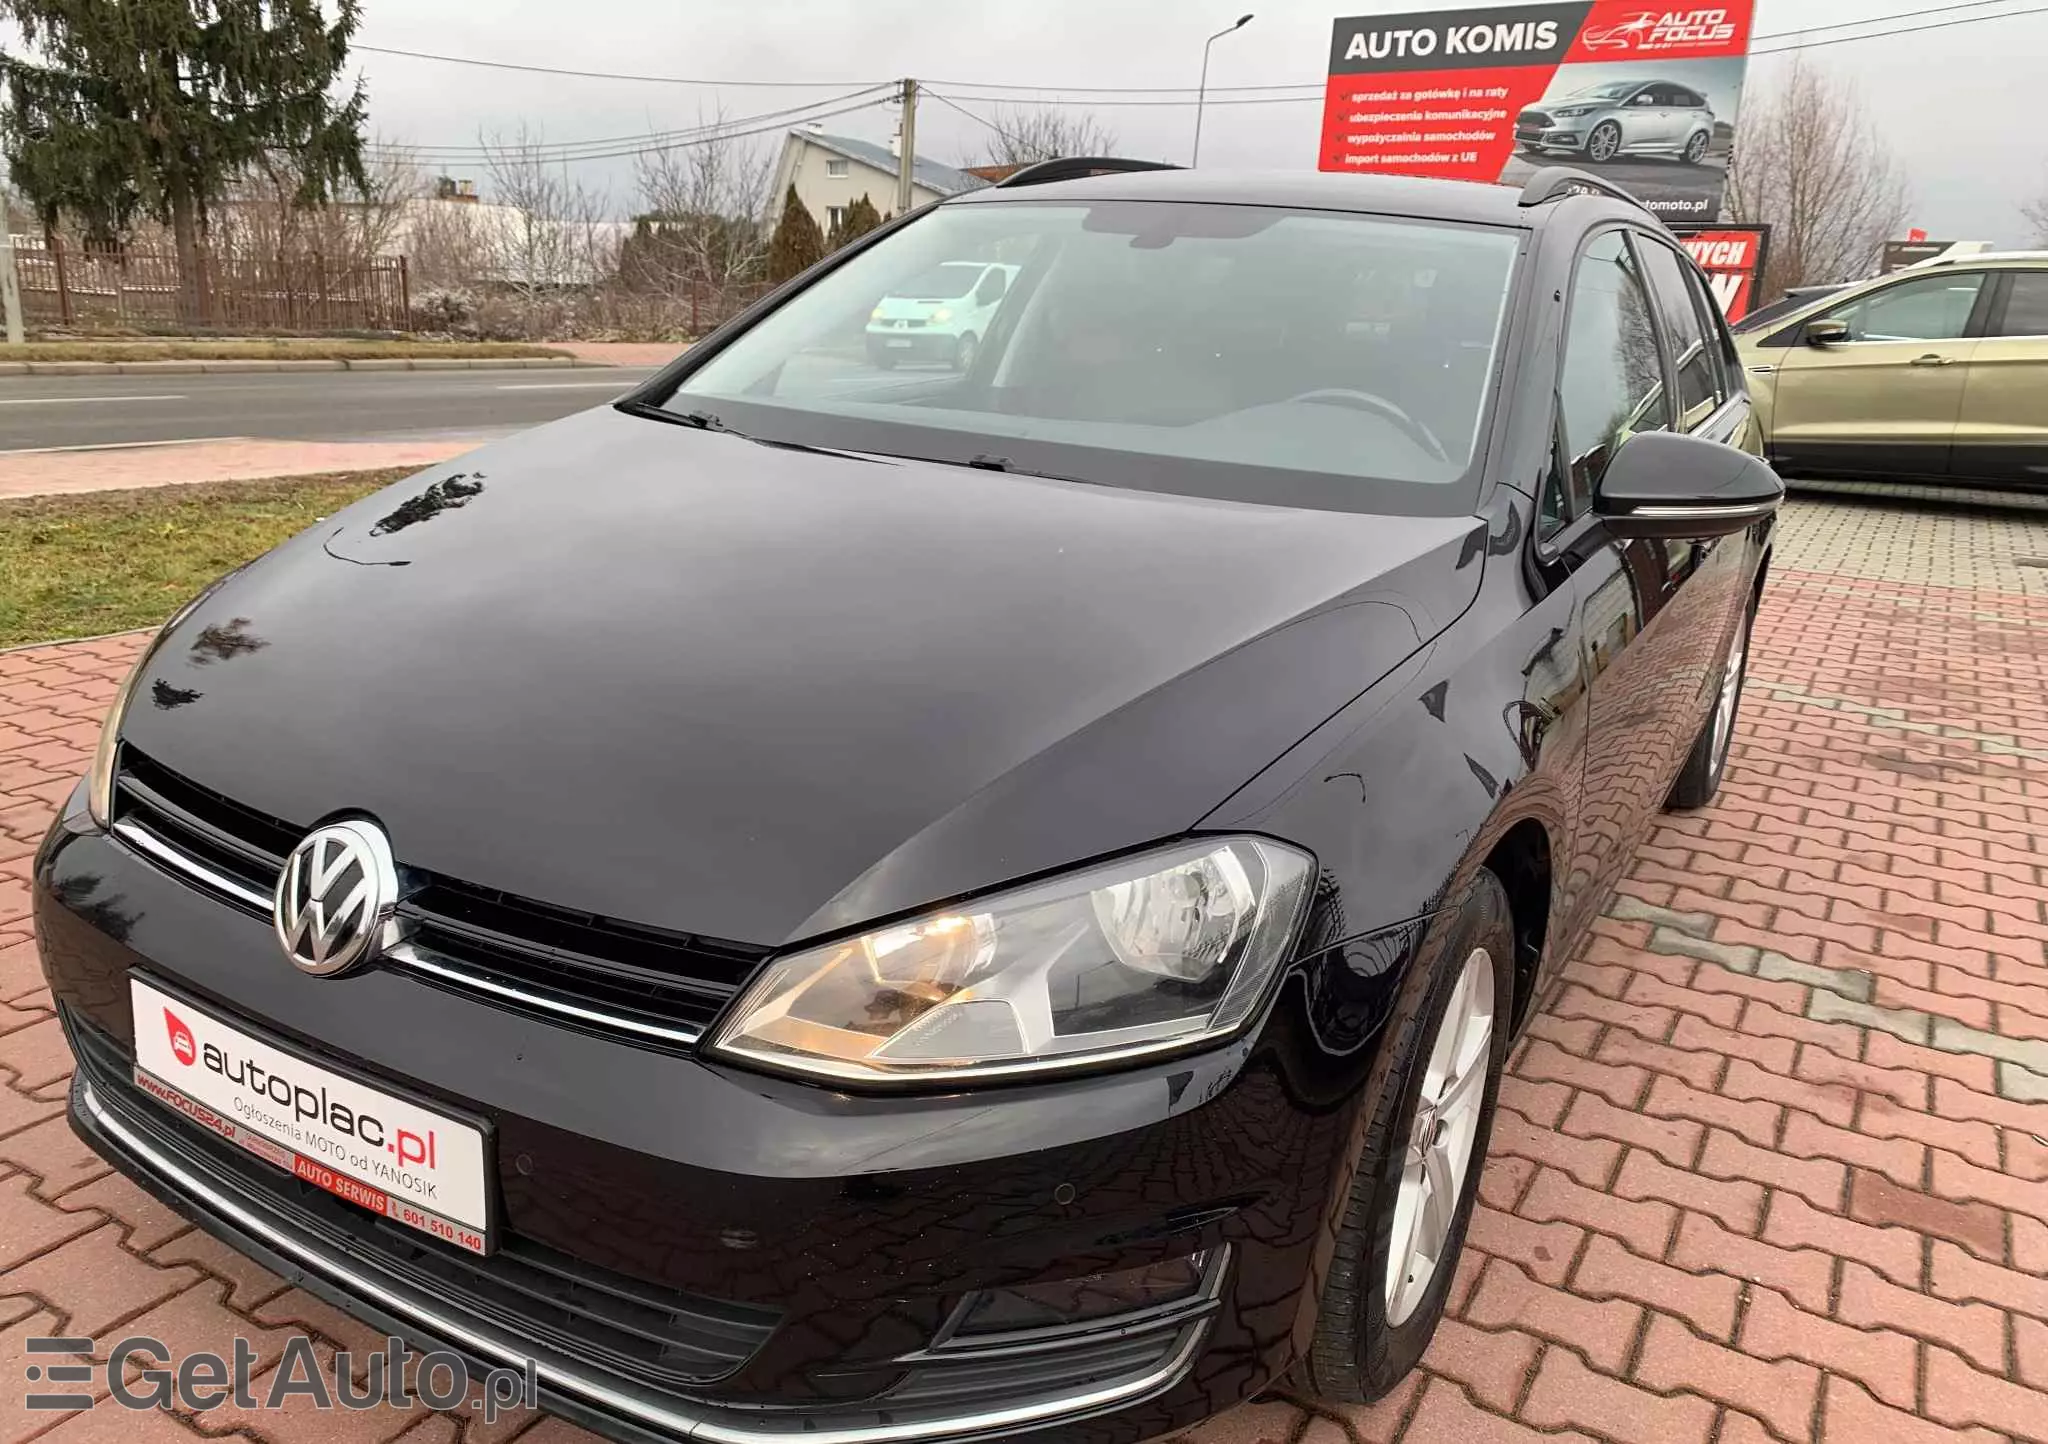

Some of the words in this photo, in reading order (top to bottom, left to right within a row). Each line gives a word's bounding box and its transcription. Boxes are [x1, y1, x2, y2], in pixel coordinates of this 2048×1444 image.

[1656, 9, 1727, 26] AUTO
[1344, 30, 1437, 60] AUTO
[1445, 20, 1559, 55] KOMIS
[1648, 24, 1736, 42] FOCUS
[1468, 88, 1483, 97] na
[1485, 86, 1508, 99] raty
[1345, 152, 1379, 166] import
[1460, 151, 1478, 162] UE
[1645, 199, 1709, 213] tomoto.pl
[202, 1042, 437, 1170] autoplac.pl
[233, 1096, 301, 1140] Ogłoszenia
[305, 1131, 346, 1161] MOTO
[350, 1152, 368, 1170] od
[372, 1159, 438, 1200] YANOSIK
[297, 1160, 332, 1188] AUTO
[335, 1177, 385, 1212] SERWIS
[403, 1208, 425, 1227] 601
[431, 1219, 454, 1239] 510
[458, 1231, 481, 1250] 140
